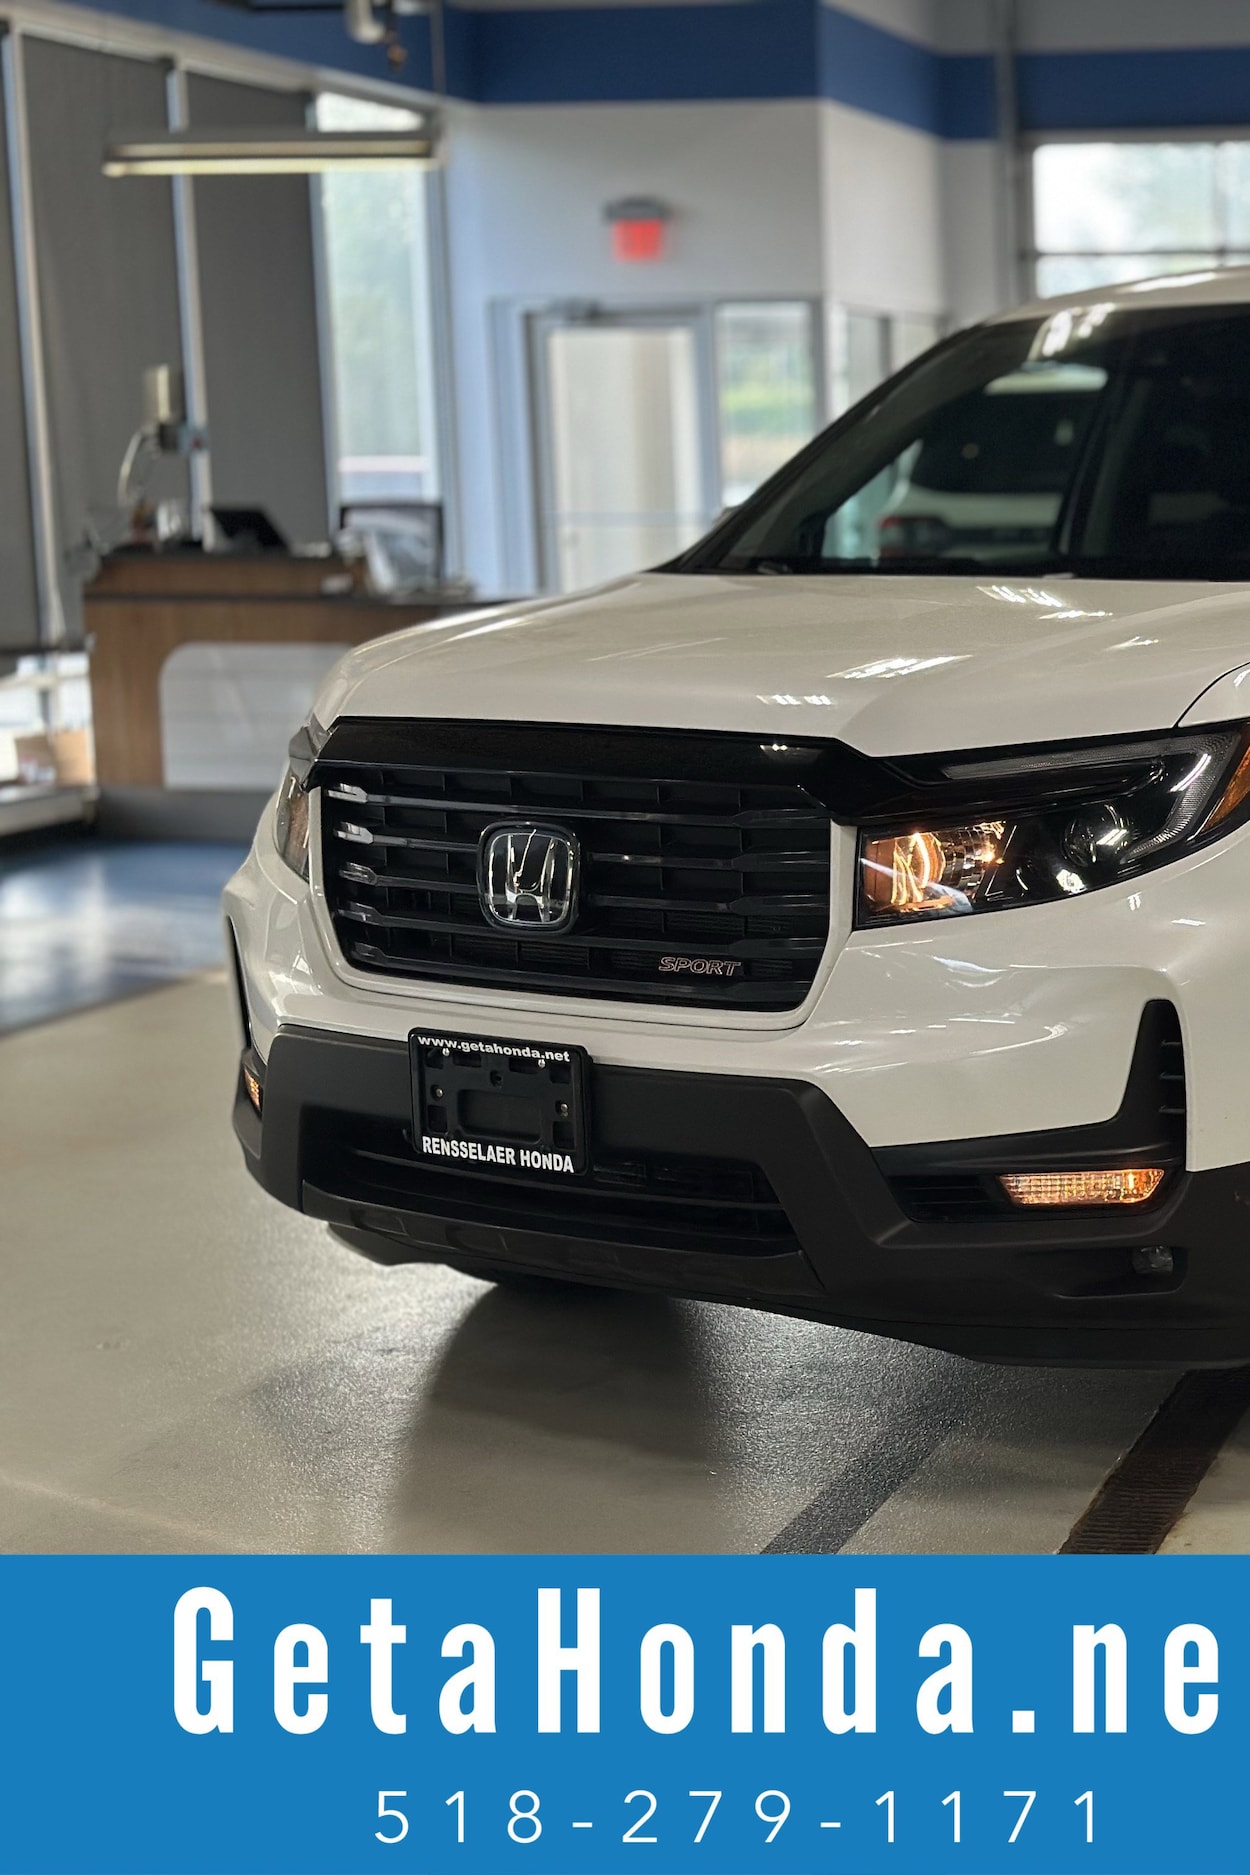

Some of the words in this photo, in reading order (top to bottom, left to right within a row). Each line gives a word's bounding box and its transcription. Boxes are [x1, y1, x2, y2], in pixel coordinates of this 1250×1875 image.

[658, 956, 742, 976] SPORT
[418, 1036, 571, 1063] www.getahonda.net
[422, 1135, 517, 1166] RENSSELAER
[520, 1149, 575, 1174] HONDA
